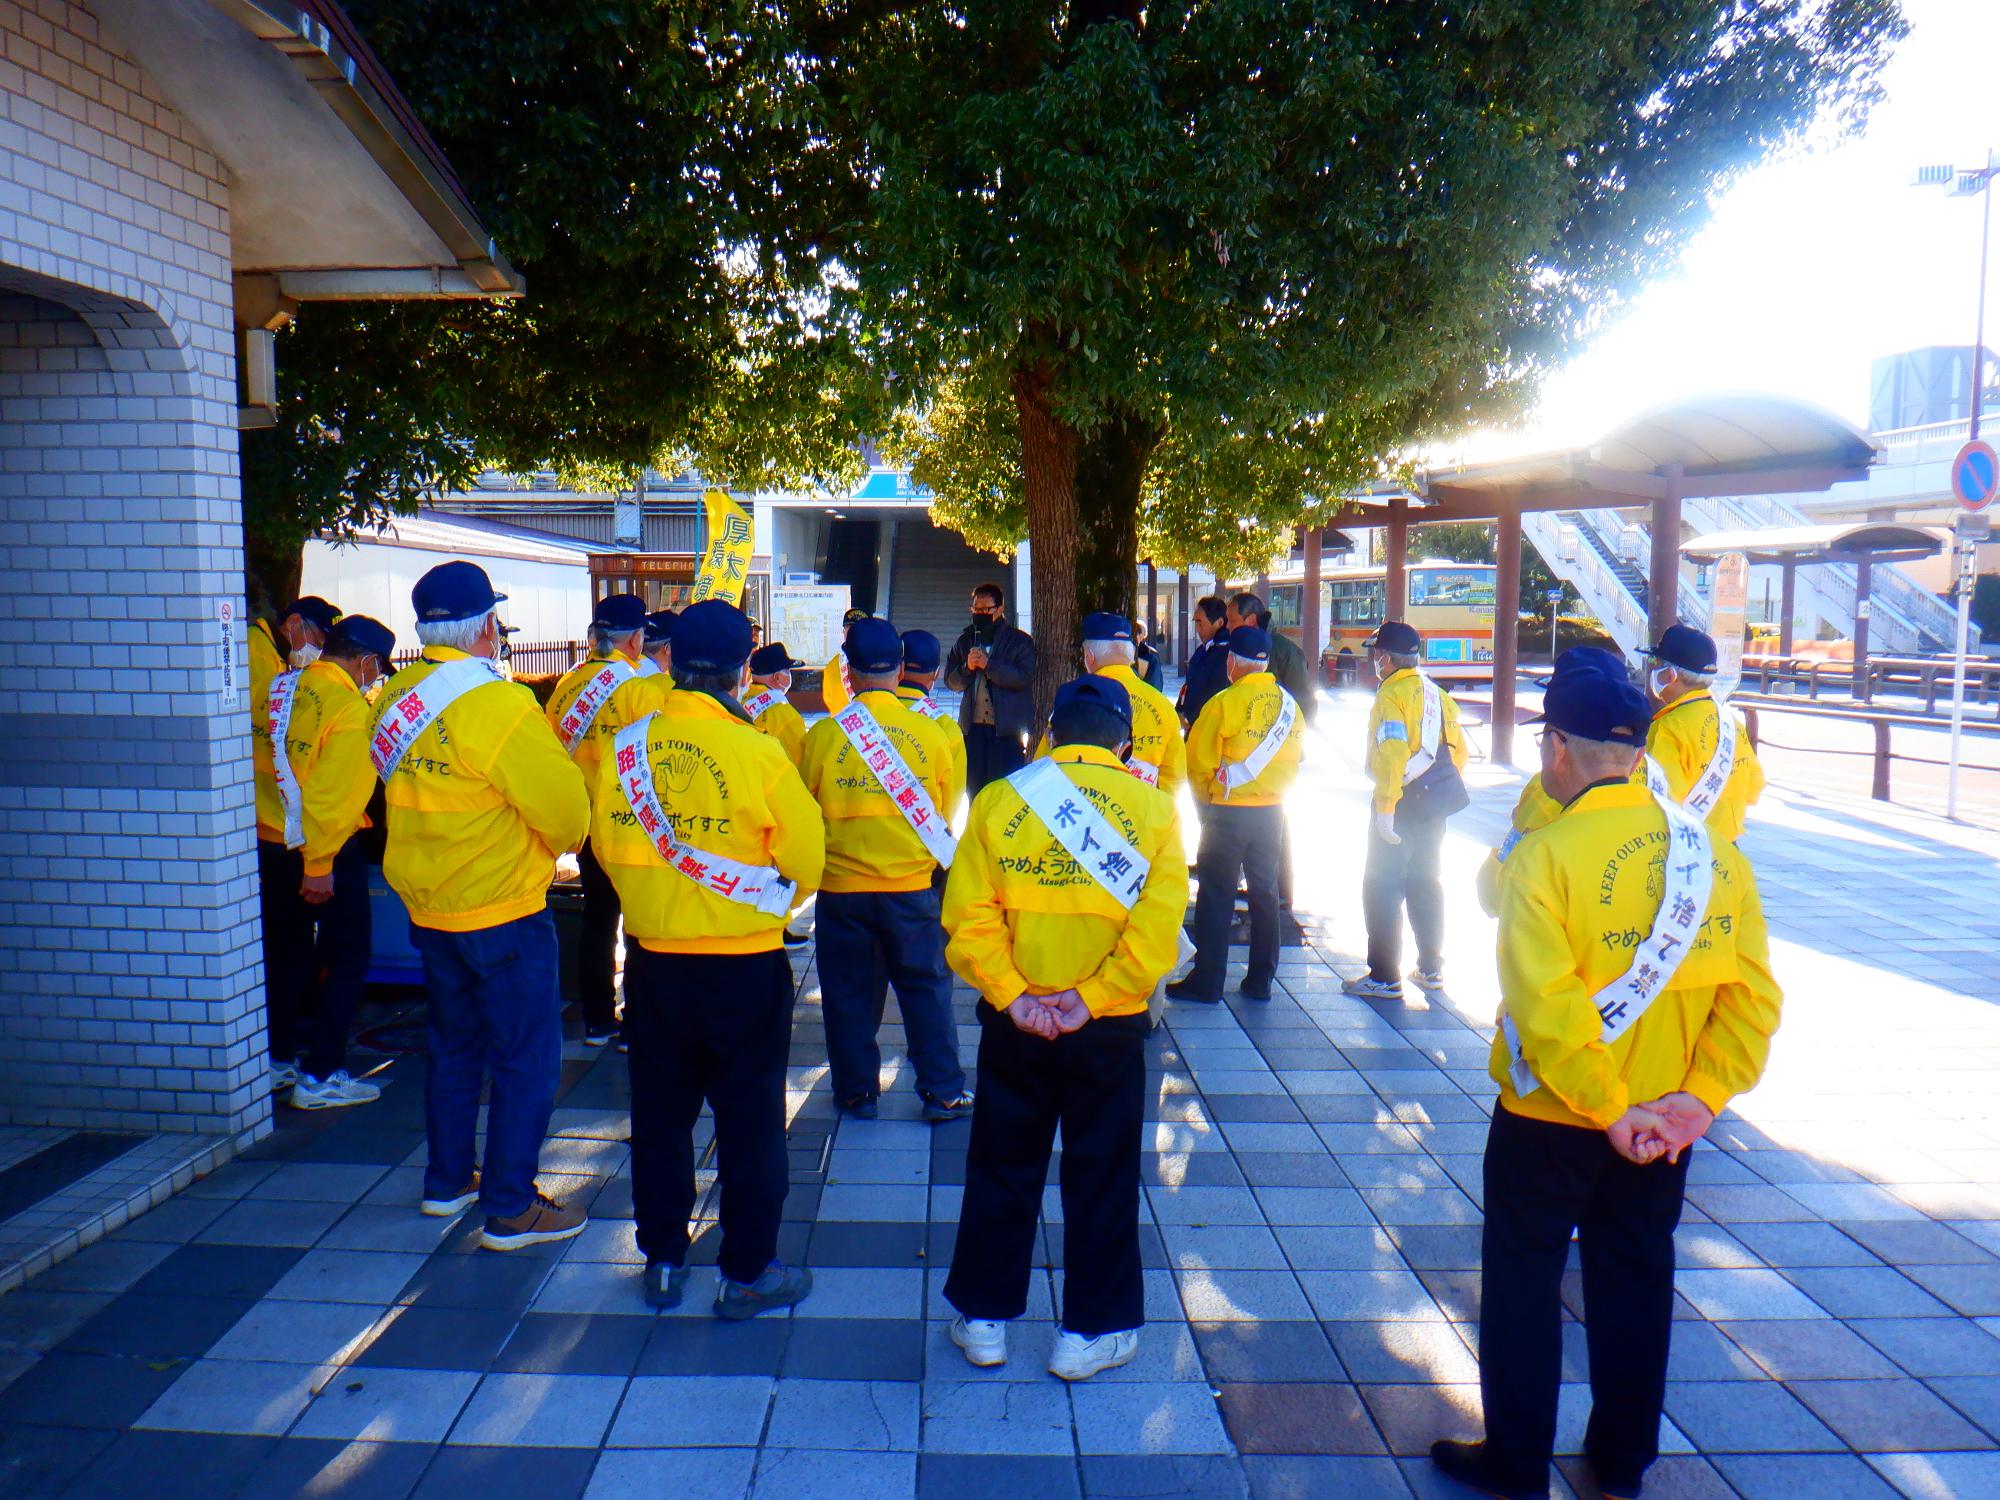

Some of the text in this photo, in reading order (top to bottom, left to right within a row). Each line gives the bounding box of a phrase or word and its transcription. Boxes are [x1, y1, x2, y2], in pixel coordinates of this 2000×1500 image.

[641, 561, 697, 570] TELEPHO
[881, 725, 909, 737] OWN
[647, 739, 729, 800] UR TOWN CLEAN
[1078, 786, 1112, 804] OWN
[610, 809, 731, 835] やめポイすて
[1600, 858, 1619, 906] KEEP
[1616, 836, 1647, 861] OUR
